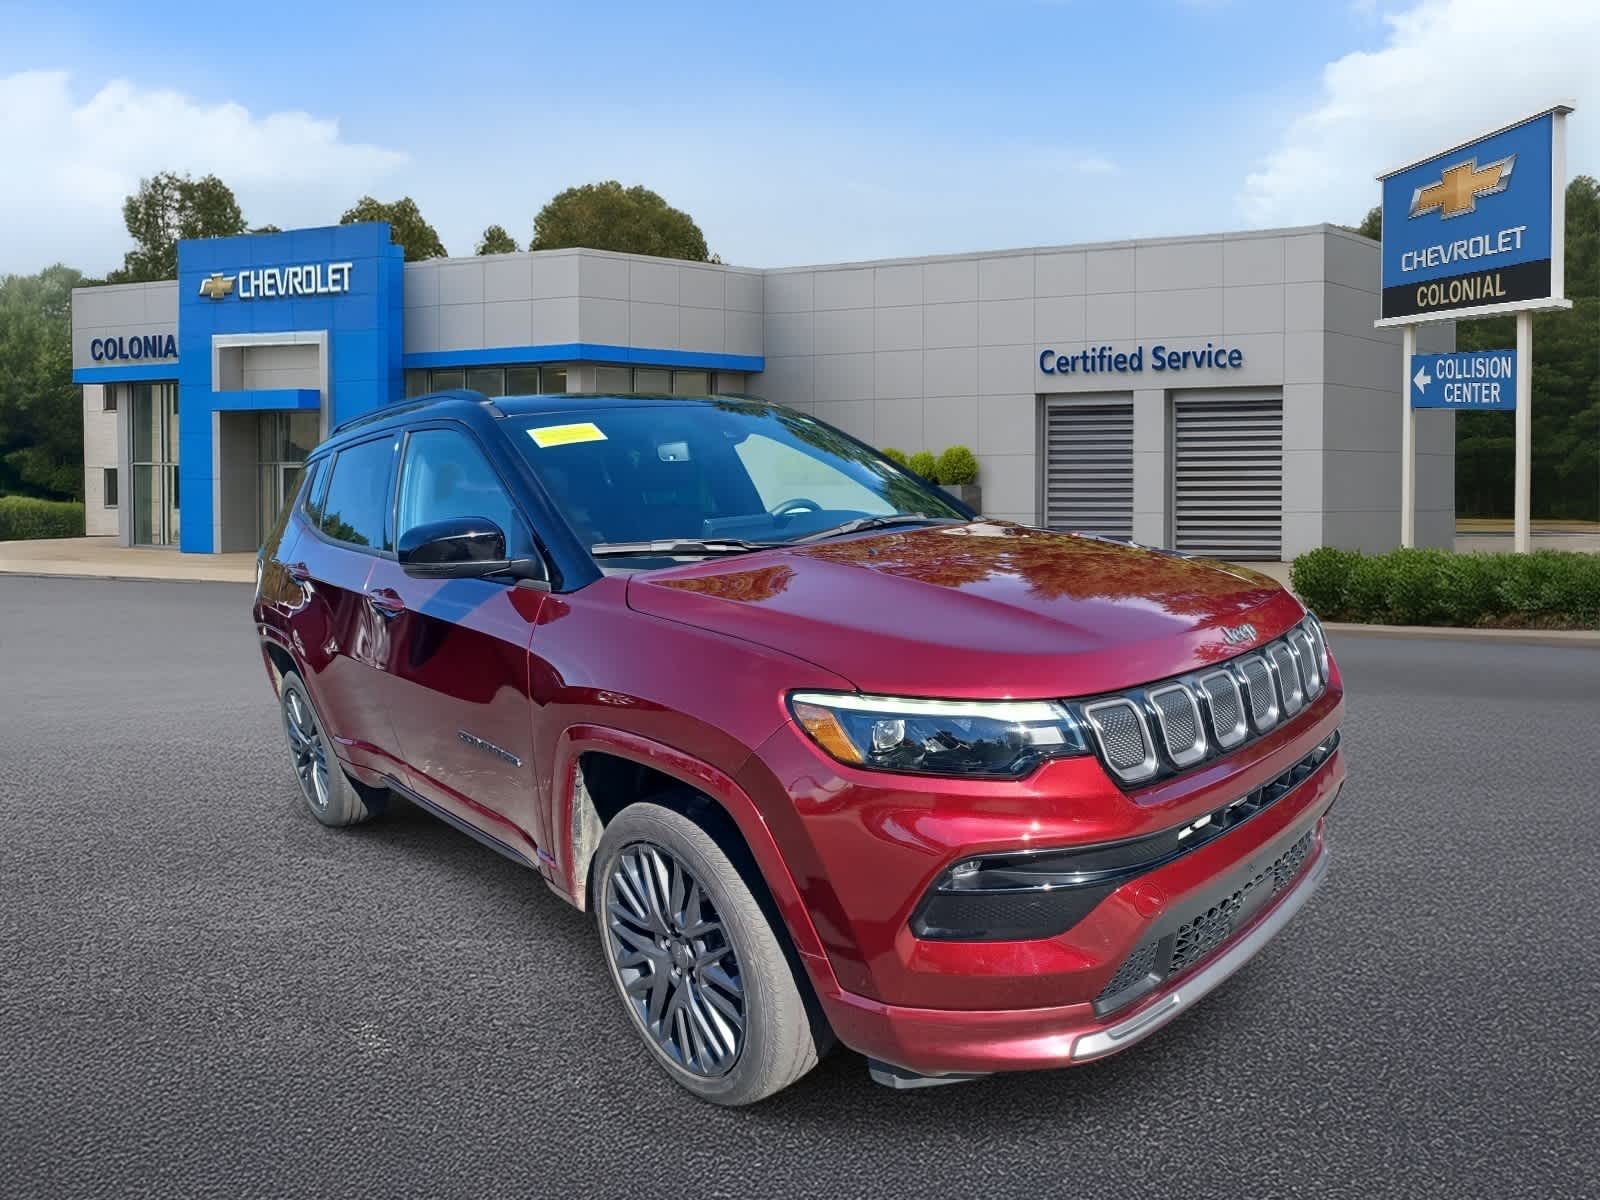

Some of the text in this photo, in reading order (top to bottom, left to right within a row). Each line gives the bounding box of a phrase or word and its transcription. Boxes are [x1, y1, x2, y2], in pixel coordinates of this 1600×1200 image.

[1402, 225, 1527, 272] CHEVROLET
[238, 262, 353, 298] CHEVROLET
[1417, 274, 1506, 307] COLONIAL
[1039, 343, 1243, 375] Certified Service
[1436, 357, 1512, 380] COLLISION
[1444, 383, 1501, 403] CENTER
